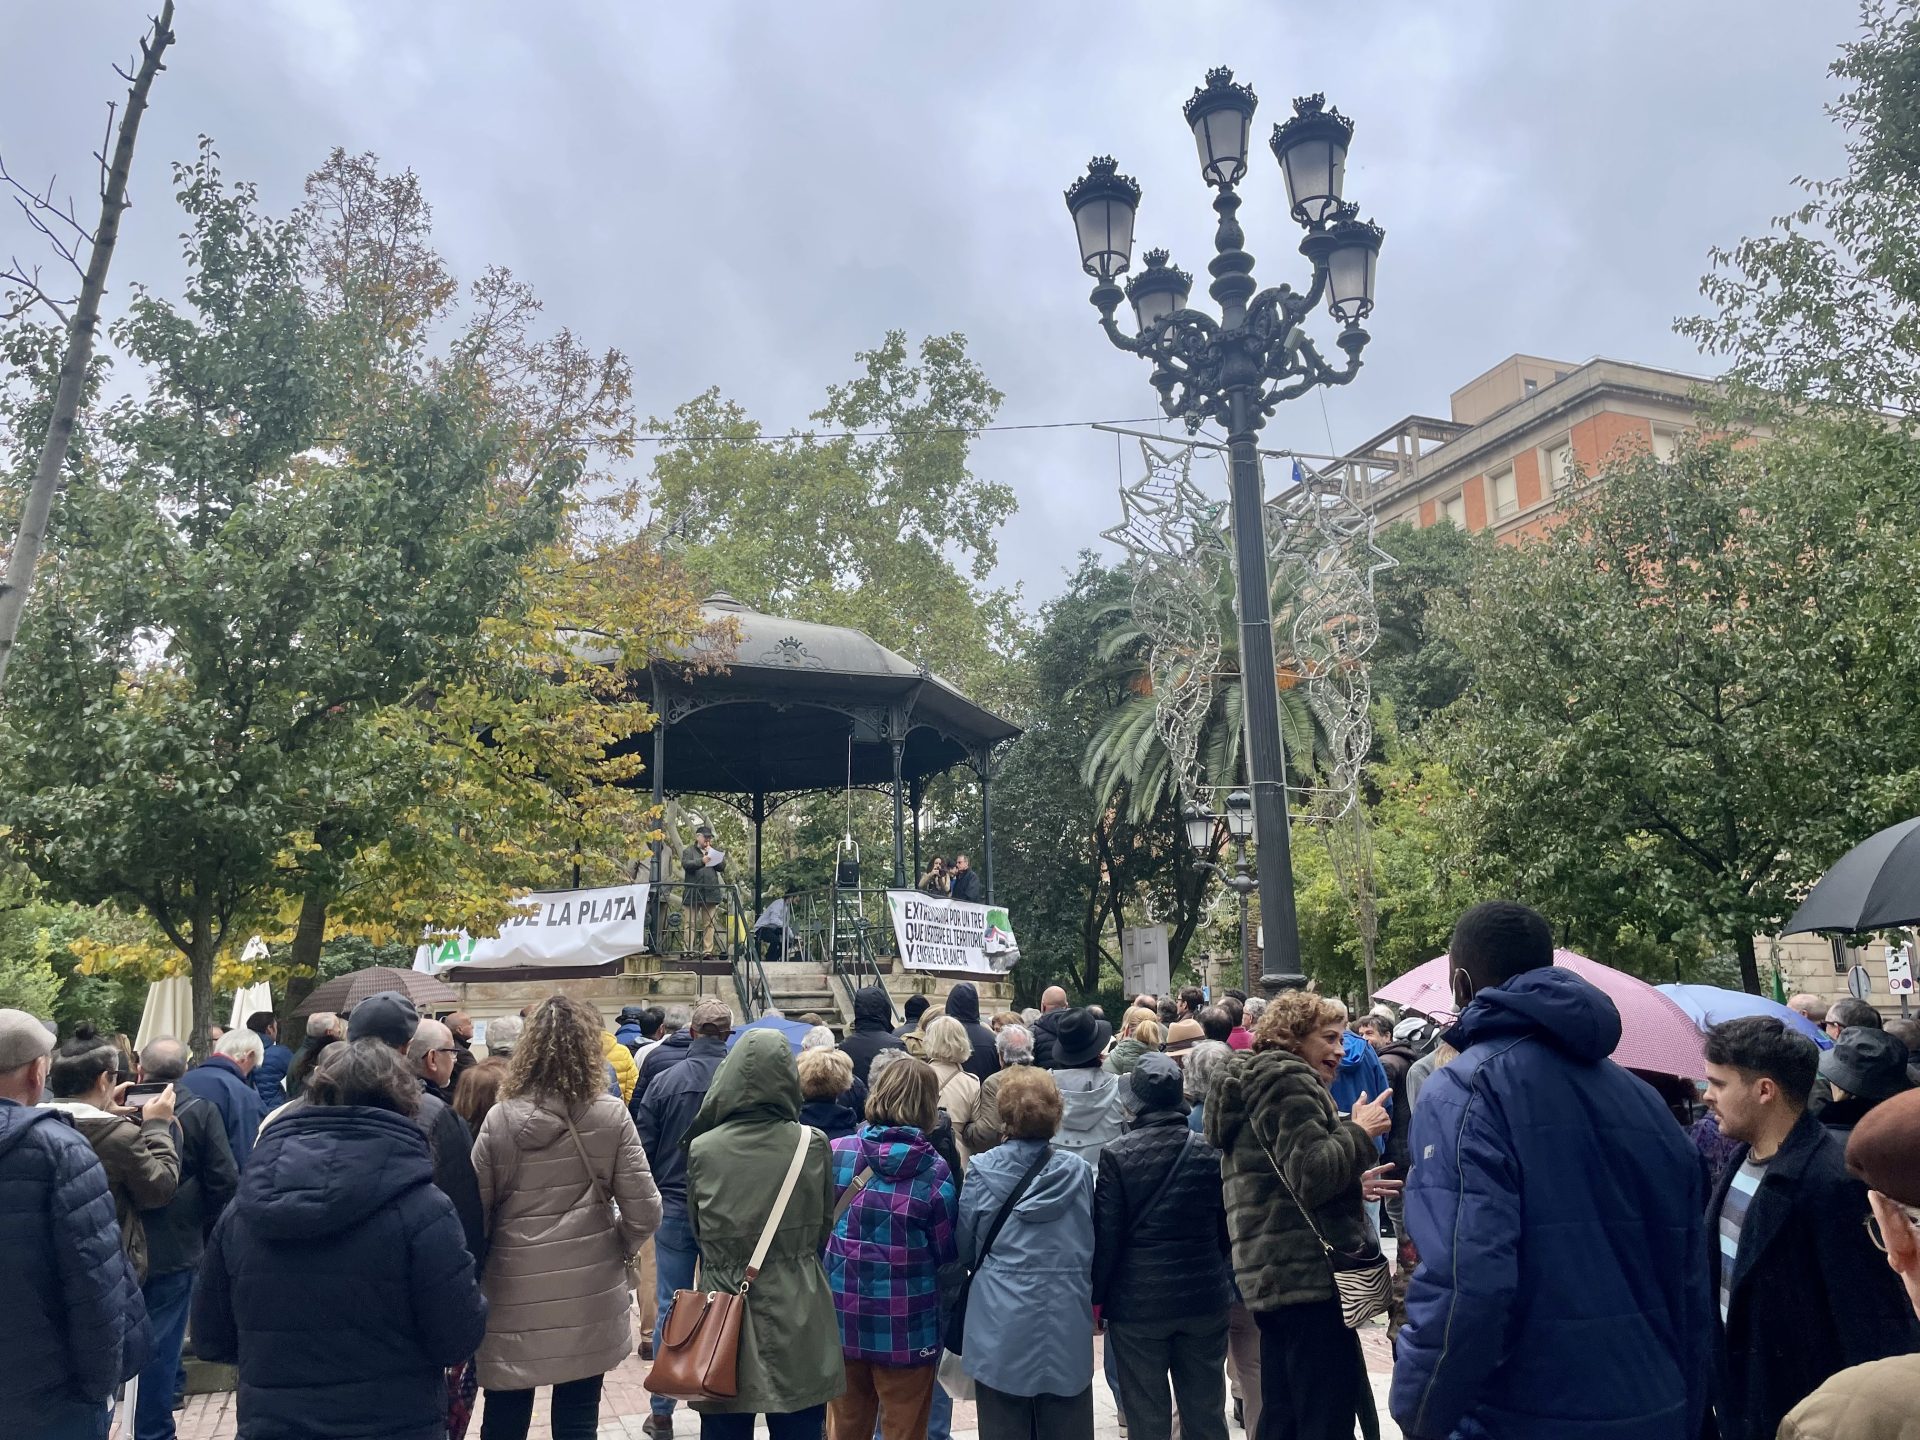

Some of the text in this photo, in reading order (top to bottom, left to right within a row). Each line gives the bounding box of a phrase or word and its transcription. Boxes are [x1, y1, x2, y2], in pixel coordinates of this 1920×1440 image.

[512, 903, 543, 927] DE
[546, 902, 571, 926] LA
[577, 896, 637, 925] PLATA
[950, 909, 961, 927] POR
[962, 911, 970, 928] UN
[906, 922, 923, 943] QUE
[946, 927, 953, 946] EL
[906, 944, 915, 962] Y
[936, 947, 944, 965] EL
[944, 948, 968, 966] PLANETA
